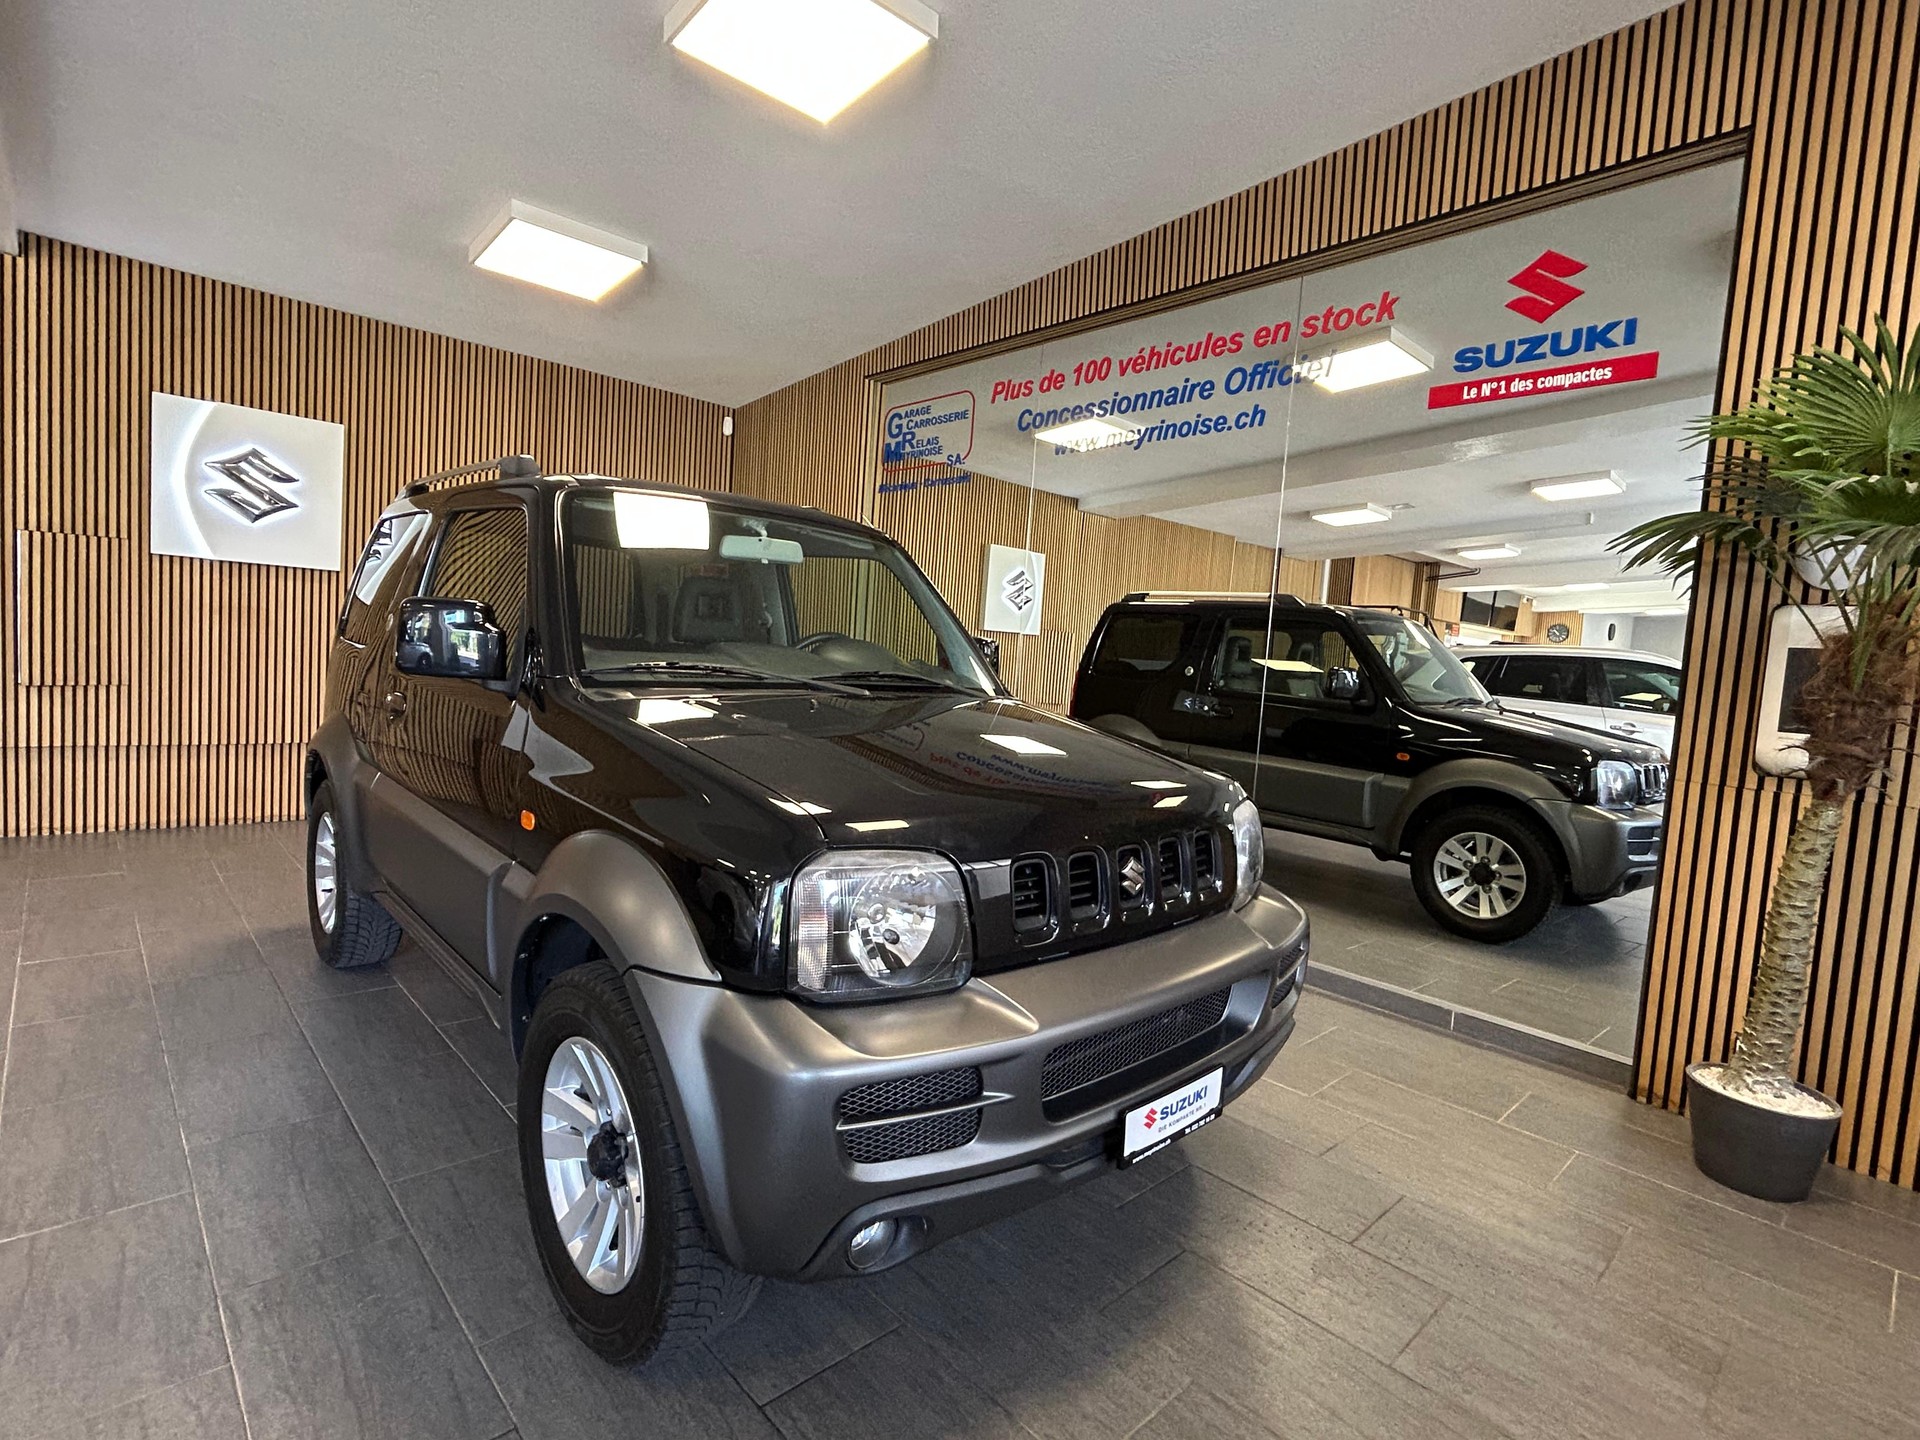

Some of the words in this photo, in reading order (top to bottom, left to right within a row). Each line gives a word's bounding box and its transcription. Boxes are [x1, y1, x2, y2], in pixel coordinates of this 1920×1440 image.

[990, 376, 1034, 404] Plus
[1038, 368, 1065, 394] de
[1072, 356, 1112, 386] 100
[1118, 331, 1244, 378] véhicules
[1253, 319, 1293, 349] en
[1300, 290, 1400, 339] stock
[1453, 317, 1638, 373] SUZUKI
[1017, 376, 1215, 432] Concessionnaire
[1224, 347, 1338, 396] Officiel
[1462, 386, 1478, 400] Le
[1510, 376, 1534, 393] des
[1536, 366, 1613, 391] compactes
[887, 405, 932, 439] GARAGE
[906, 409, 970, 431] CARROSSERIE
[902, 430, 940, 452] RELAIS
[1159, 1085, 1208, 1121] SUZUKI
